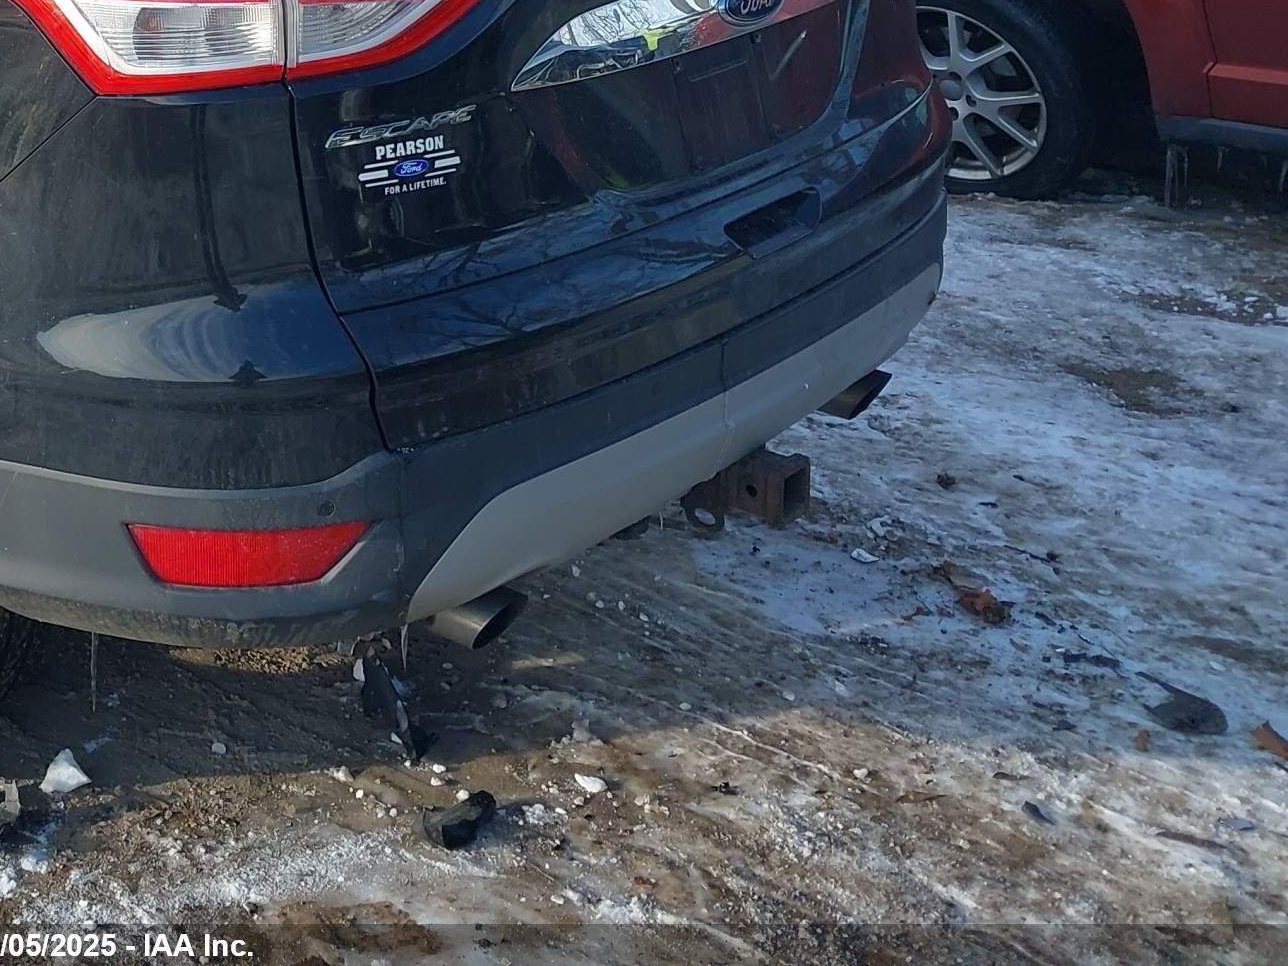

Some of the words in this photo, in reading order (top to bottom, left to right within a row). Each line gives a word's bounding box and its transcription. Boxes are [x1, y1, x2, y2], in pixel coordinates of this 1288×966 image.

[324, 104, 477, 149] ESCAPE
[375, 135, 445, 161] PEARSON
[400, 162, 423, 175] Ford
[384, 186, 401, 196] FOR
[402, 184, 408, 193] A
